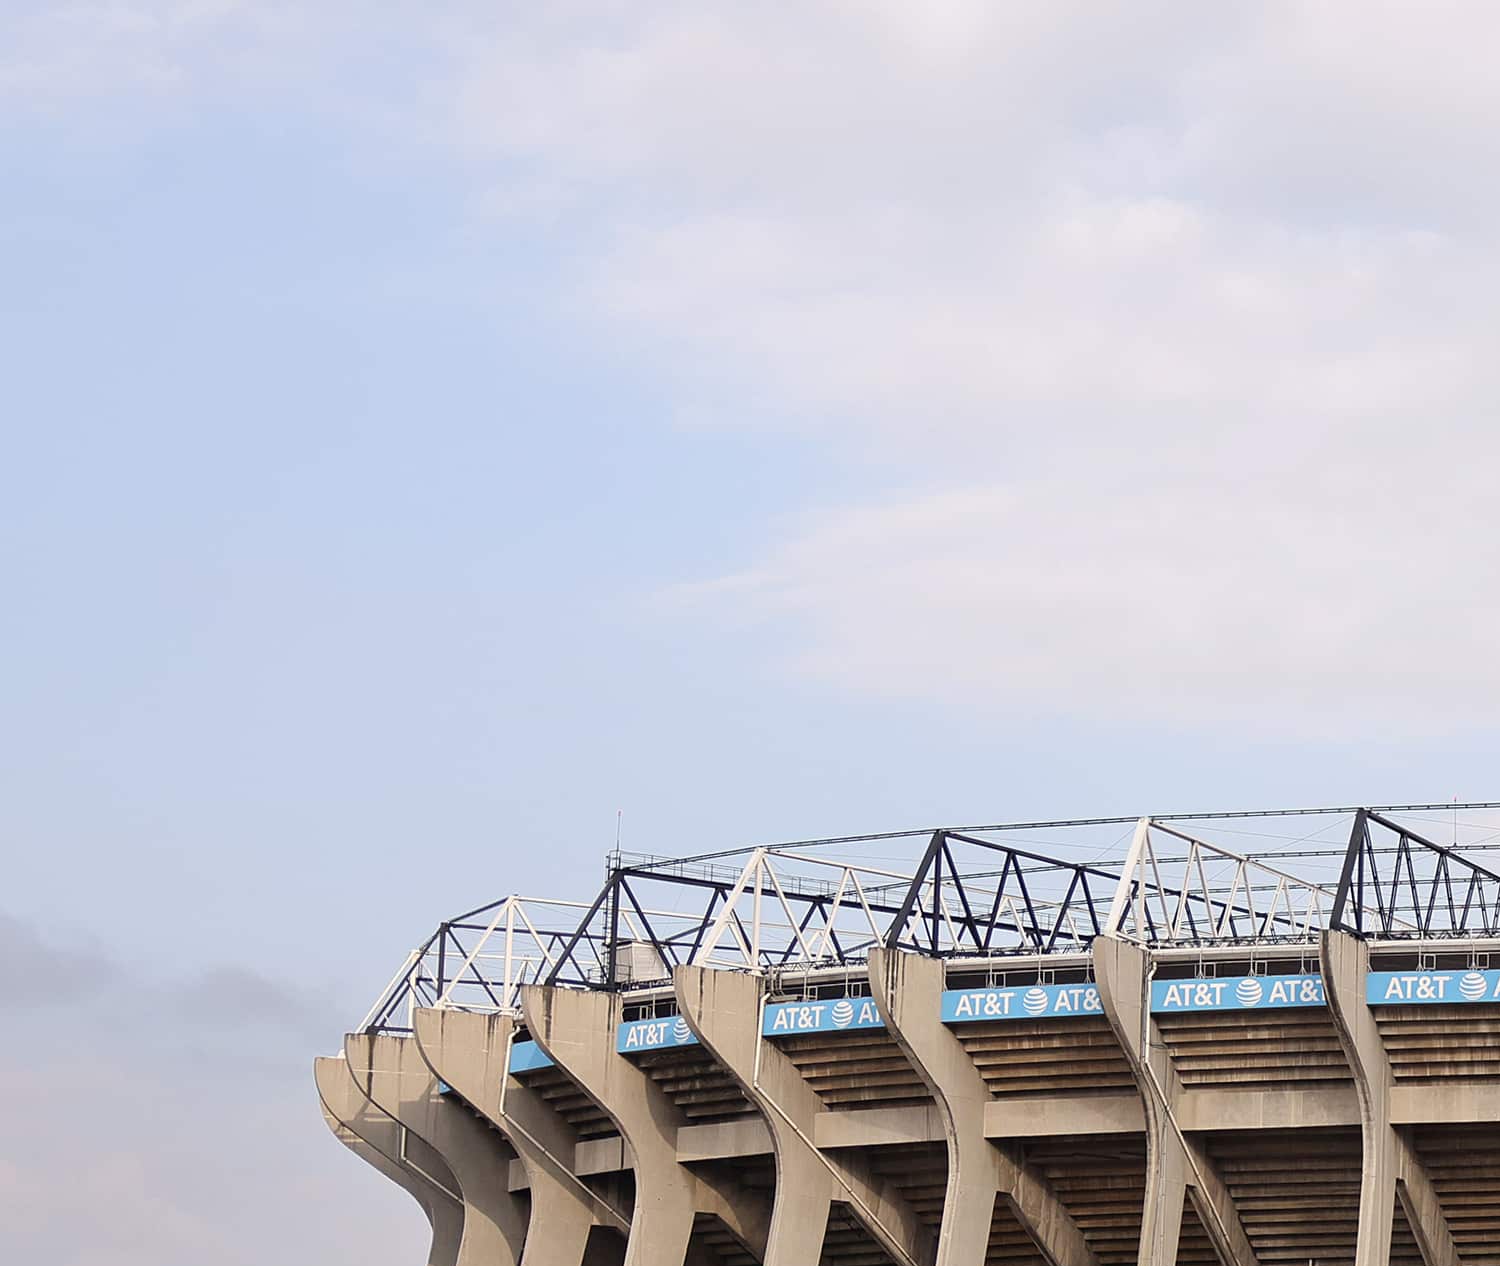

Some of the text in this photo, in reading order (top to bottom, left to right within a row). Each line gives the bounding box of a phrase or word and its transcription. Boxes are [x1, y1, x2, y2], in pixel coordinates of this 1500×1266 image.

[1162, 982, 1226, 1007] AT&T
[1384, 975, 1451, 1000] AT&T
[955, 988, 1101, 1017] AT&T AT&
[773, 1004, 824, 1030] AT&T
[625, 1022, 667, 1046] AT&T
